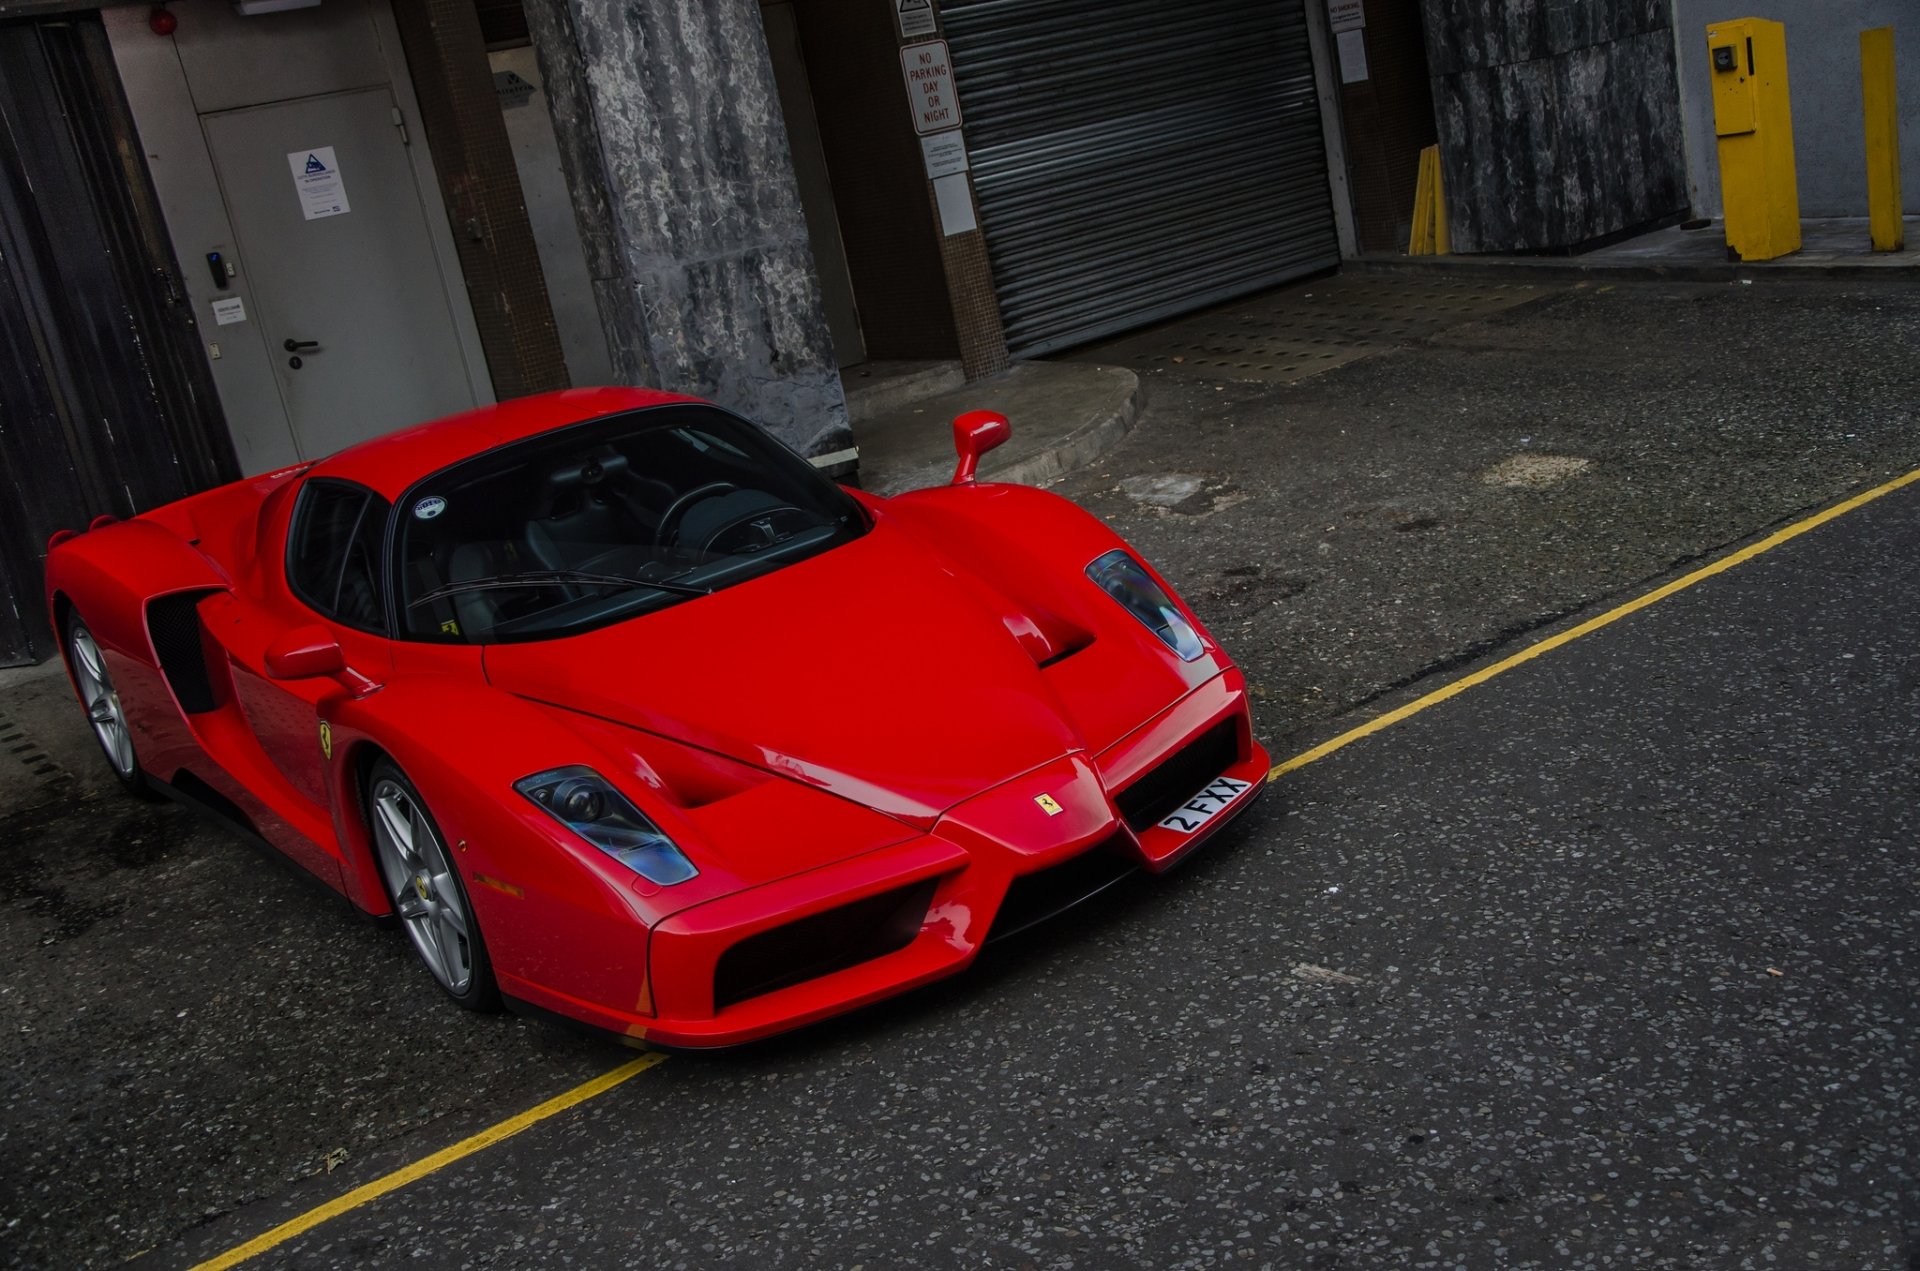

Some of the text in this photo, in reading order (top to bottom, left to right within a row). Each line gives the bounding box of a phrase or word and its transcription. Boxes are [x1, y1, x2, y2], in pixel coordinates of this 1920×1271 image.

[919, 52, 932, 65] NO
[909, 65, 947, 82] PARKING
[922, 81, 938, 94] DAY
[927, 95, 940, 108] OR
[923, 108, 949, 123] NIGHT
